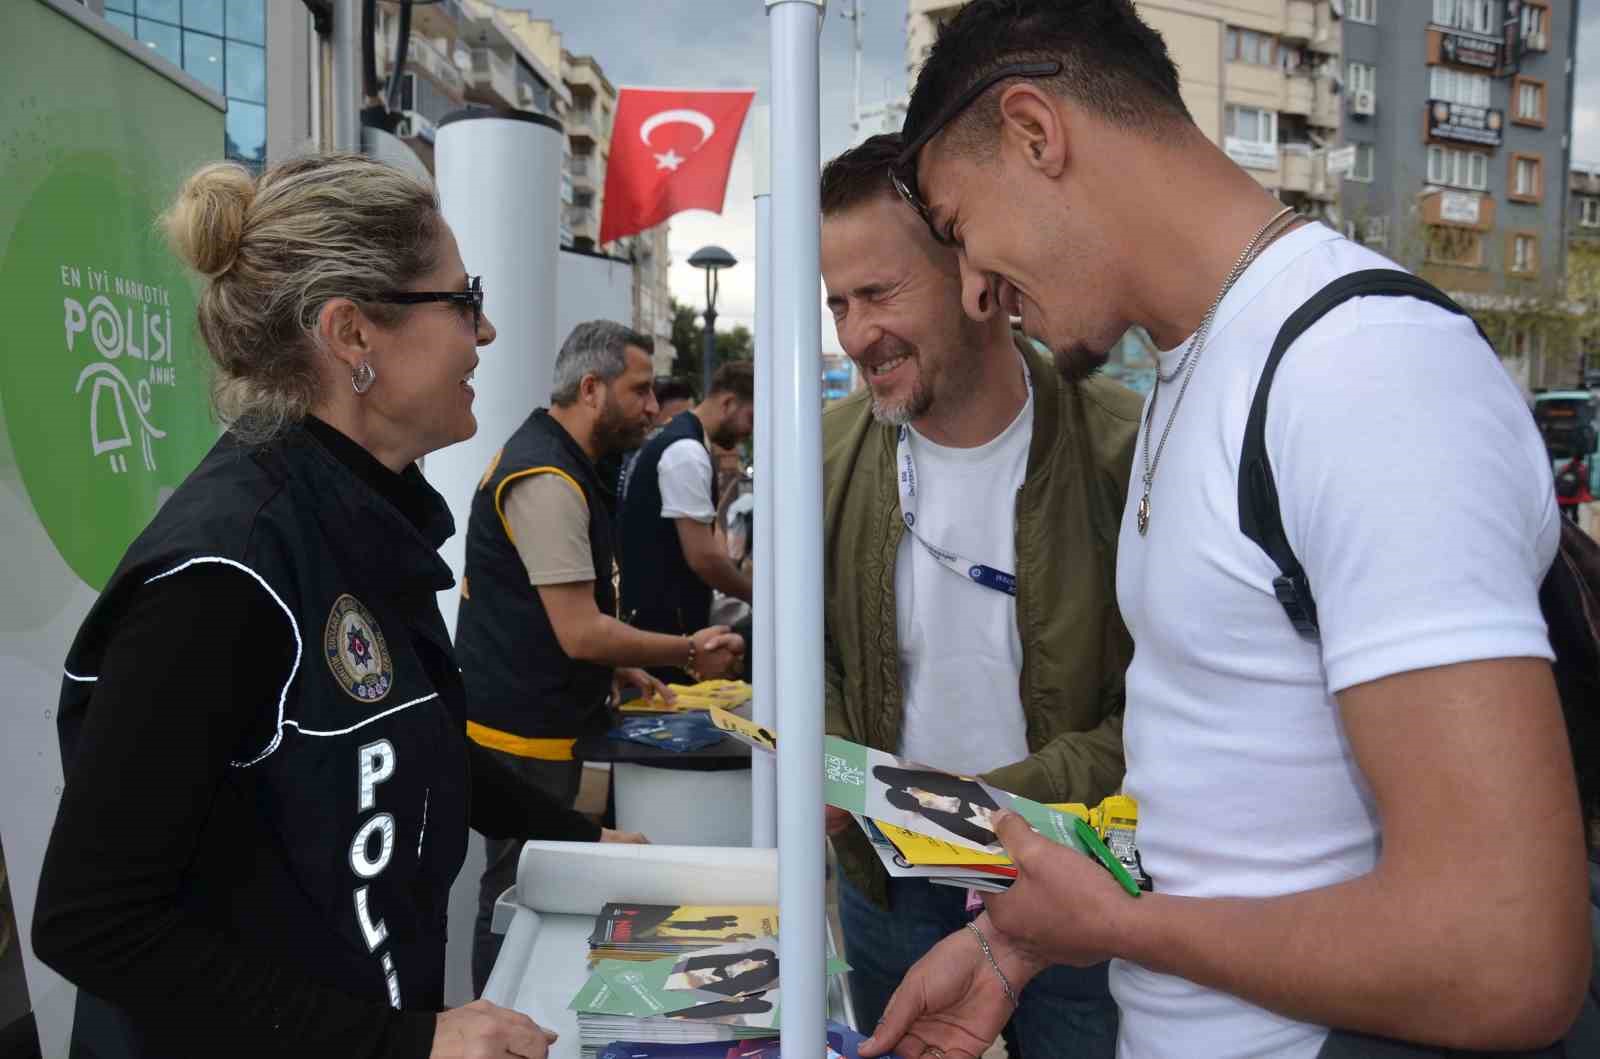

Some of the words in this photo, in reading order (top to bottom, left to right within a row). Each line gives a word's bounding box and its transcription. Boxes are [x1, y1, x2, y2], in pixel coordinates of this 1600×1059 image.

[61, 265, 81, 288] EN
[88, 266, 110, 292] İYİ
[64, 296, 172, 363] POLİSİ
